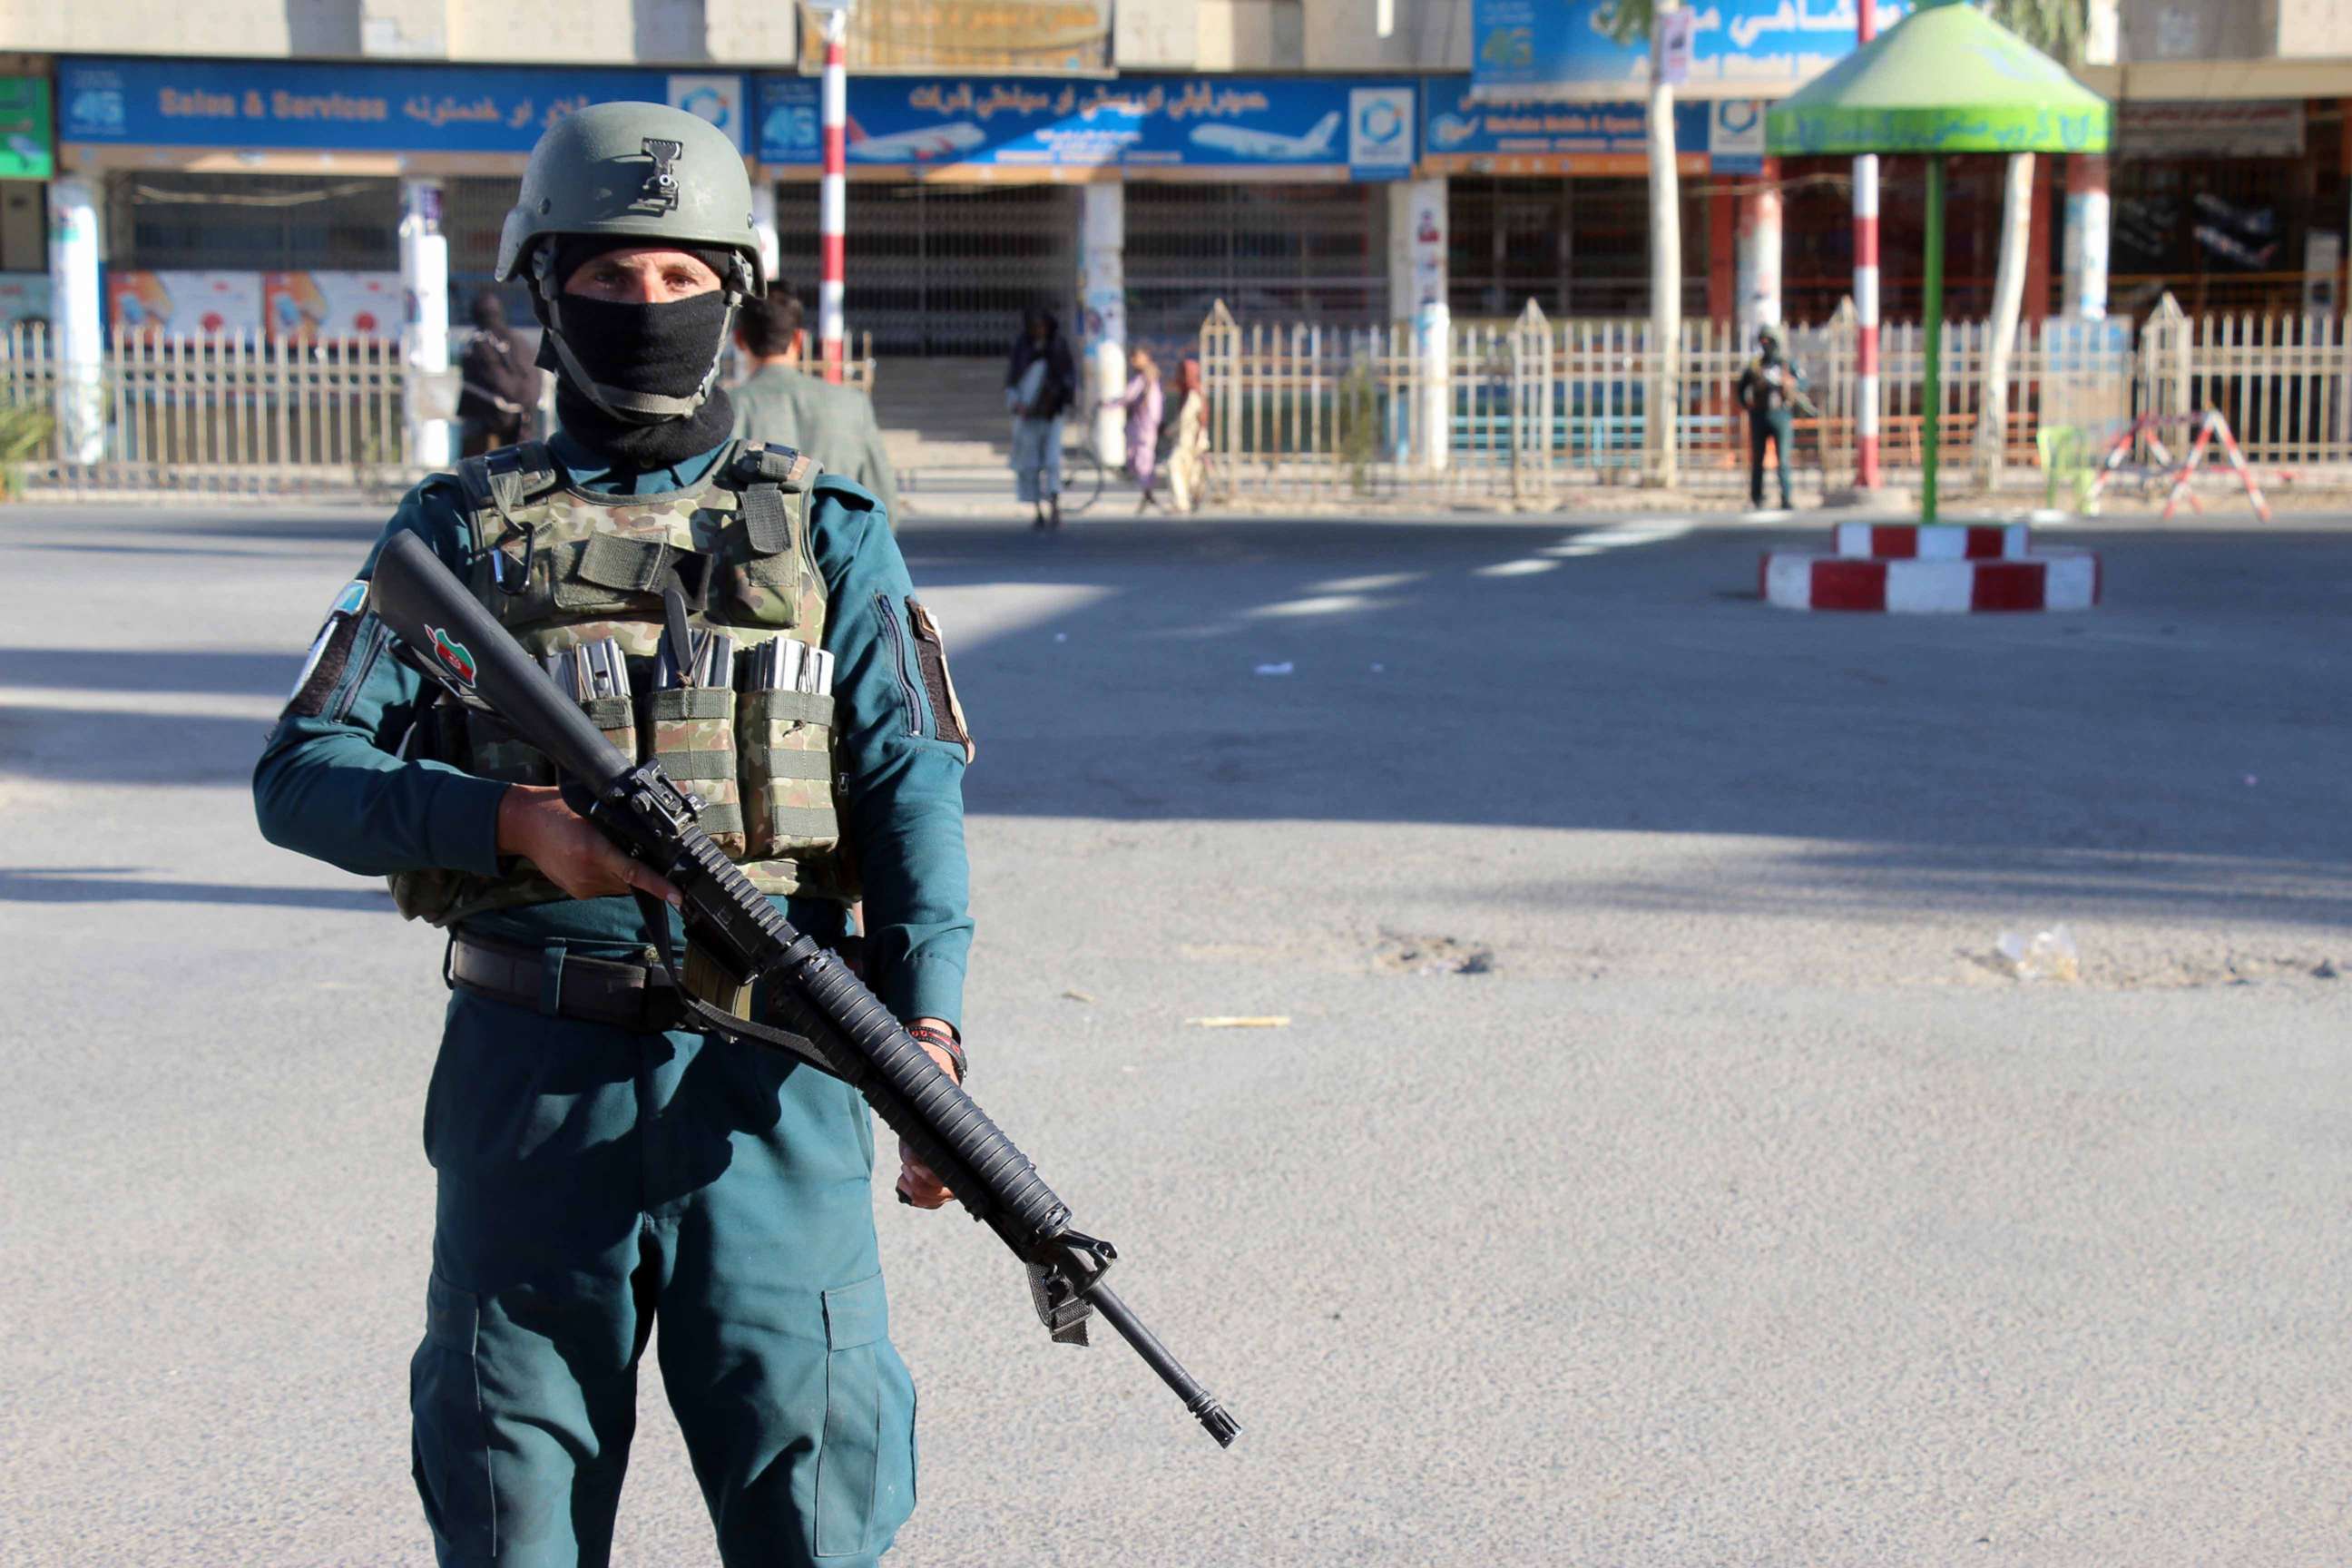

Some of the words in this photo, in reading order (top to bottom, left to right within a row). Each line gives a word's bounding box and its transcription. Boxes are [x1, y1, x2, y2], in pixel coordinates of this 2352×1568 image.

[159, 88, 236, 117] Sales
[272, 89, 387, 121] Services
[762, 106, 816, 145] 4G
